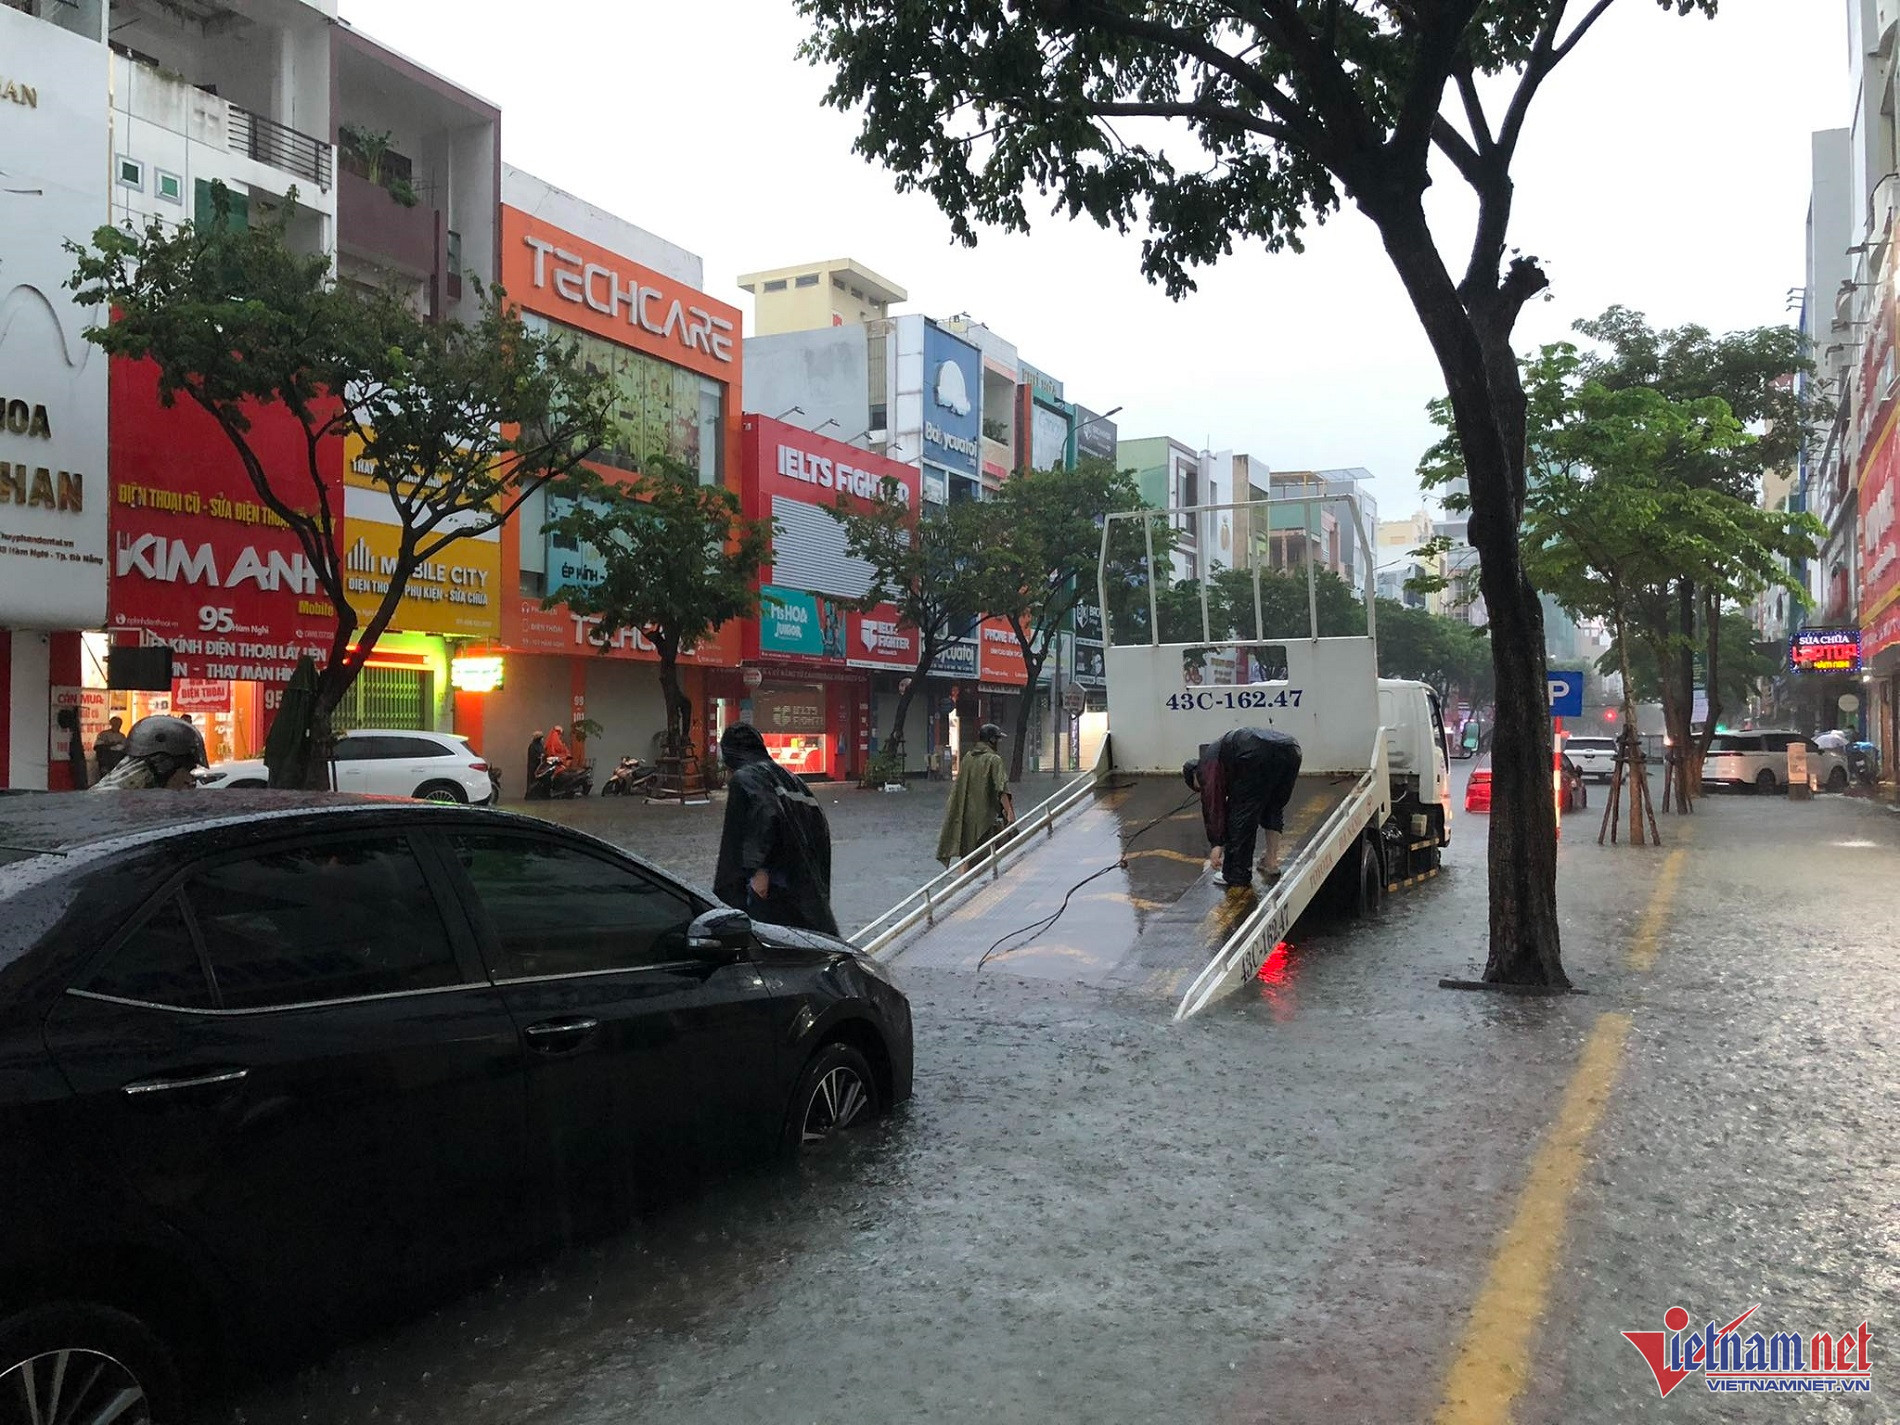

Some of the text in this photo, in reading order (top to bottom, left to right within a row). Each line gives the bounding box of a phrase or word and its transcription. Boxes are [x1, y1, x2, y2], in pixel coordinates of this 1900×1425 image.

[0, 80, 37, 109] AN
[524, 235, 733, 363] TECHCARE
[777, 444, 910, 508] IELTS FIGHTR
[150, 488, 182, 515] THOẠI
[185, 490, 200, 514] CŨ
[210, 492, 232, 519] SỬA
[235, 502, 259, 526] ĐIỆN
[116, 531, 220, 587] KIM
[381, 555, 489, 587] MBILE CITY
[348, 577, 371, 594] ĐIỆN
[404, 584, 422, 599] PHỤ
[198, 605, 234, 633] 95
[206, 637, 236, 659] ĐIỆN
[240, 642, 277, 660] THOẠI
[206, 663, 238, 679] THAY
[241, 664, 273, 681] MÀN
[1166, 689, 1303, 711] 43C-162.47
[1549, 680, 1570, 706] P
